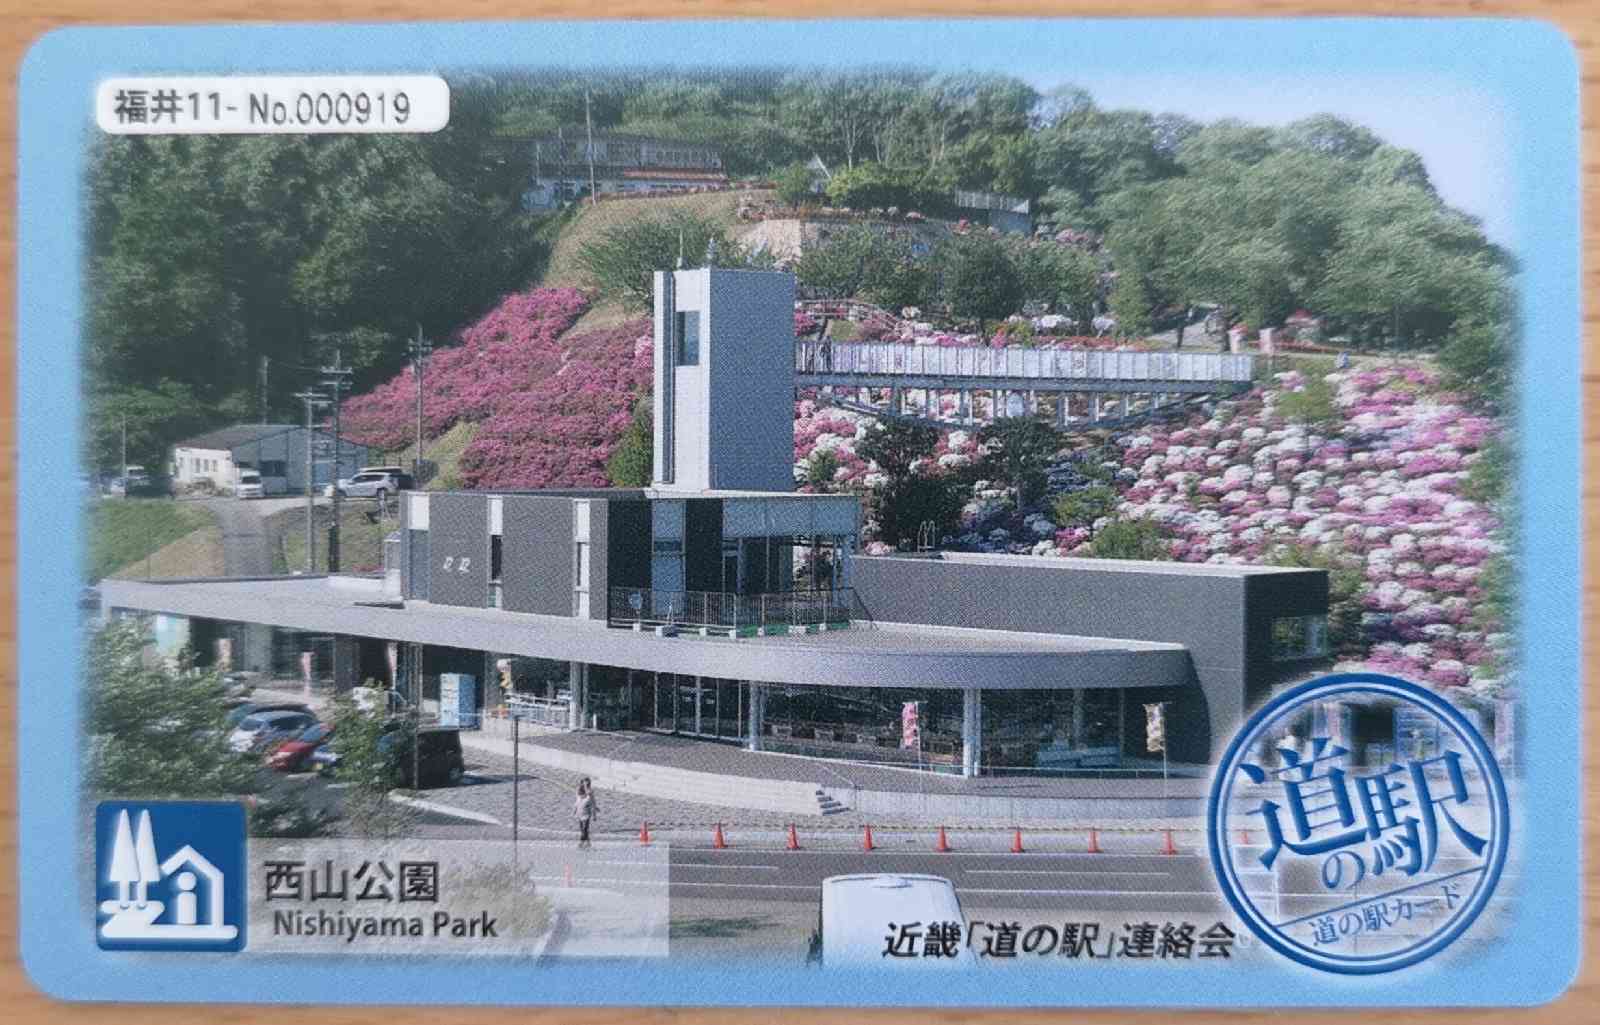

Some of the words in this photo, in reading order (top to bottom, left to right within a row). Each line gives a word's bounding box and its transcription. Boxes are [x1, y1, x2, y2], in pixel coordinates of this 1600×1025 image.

[1239, 737, 1488, 890] 道の駅
[264, 859, 439, 903] 西山公園
[273, 909, 423, 943] Nishiyama
[433, 910, 499, 938] Park
[1305, 883, 1460, 946] 道の駅カード
[882, 921, 1236, 959] 近畿「道の駅」連絡会
